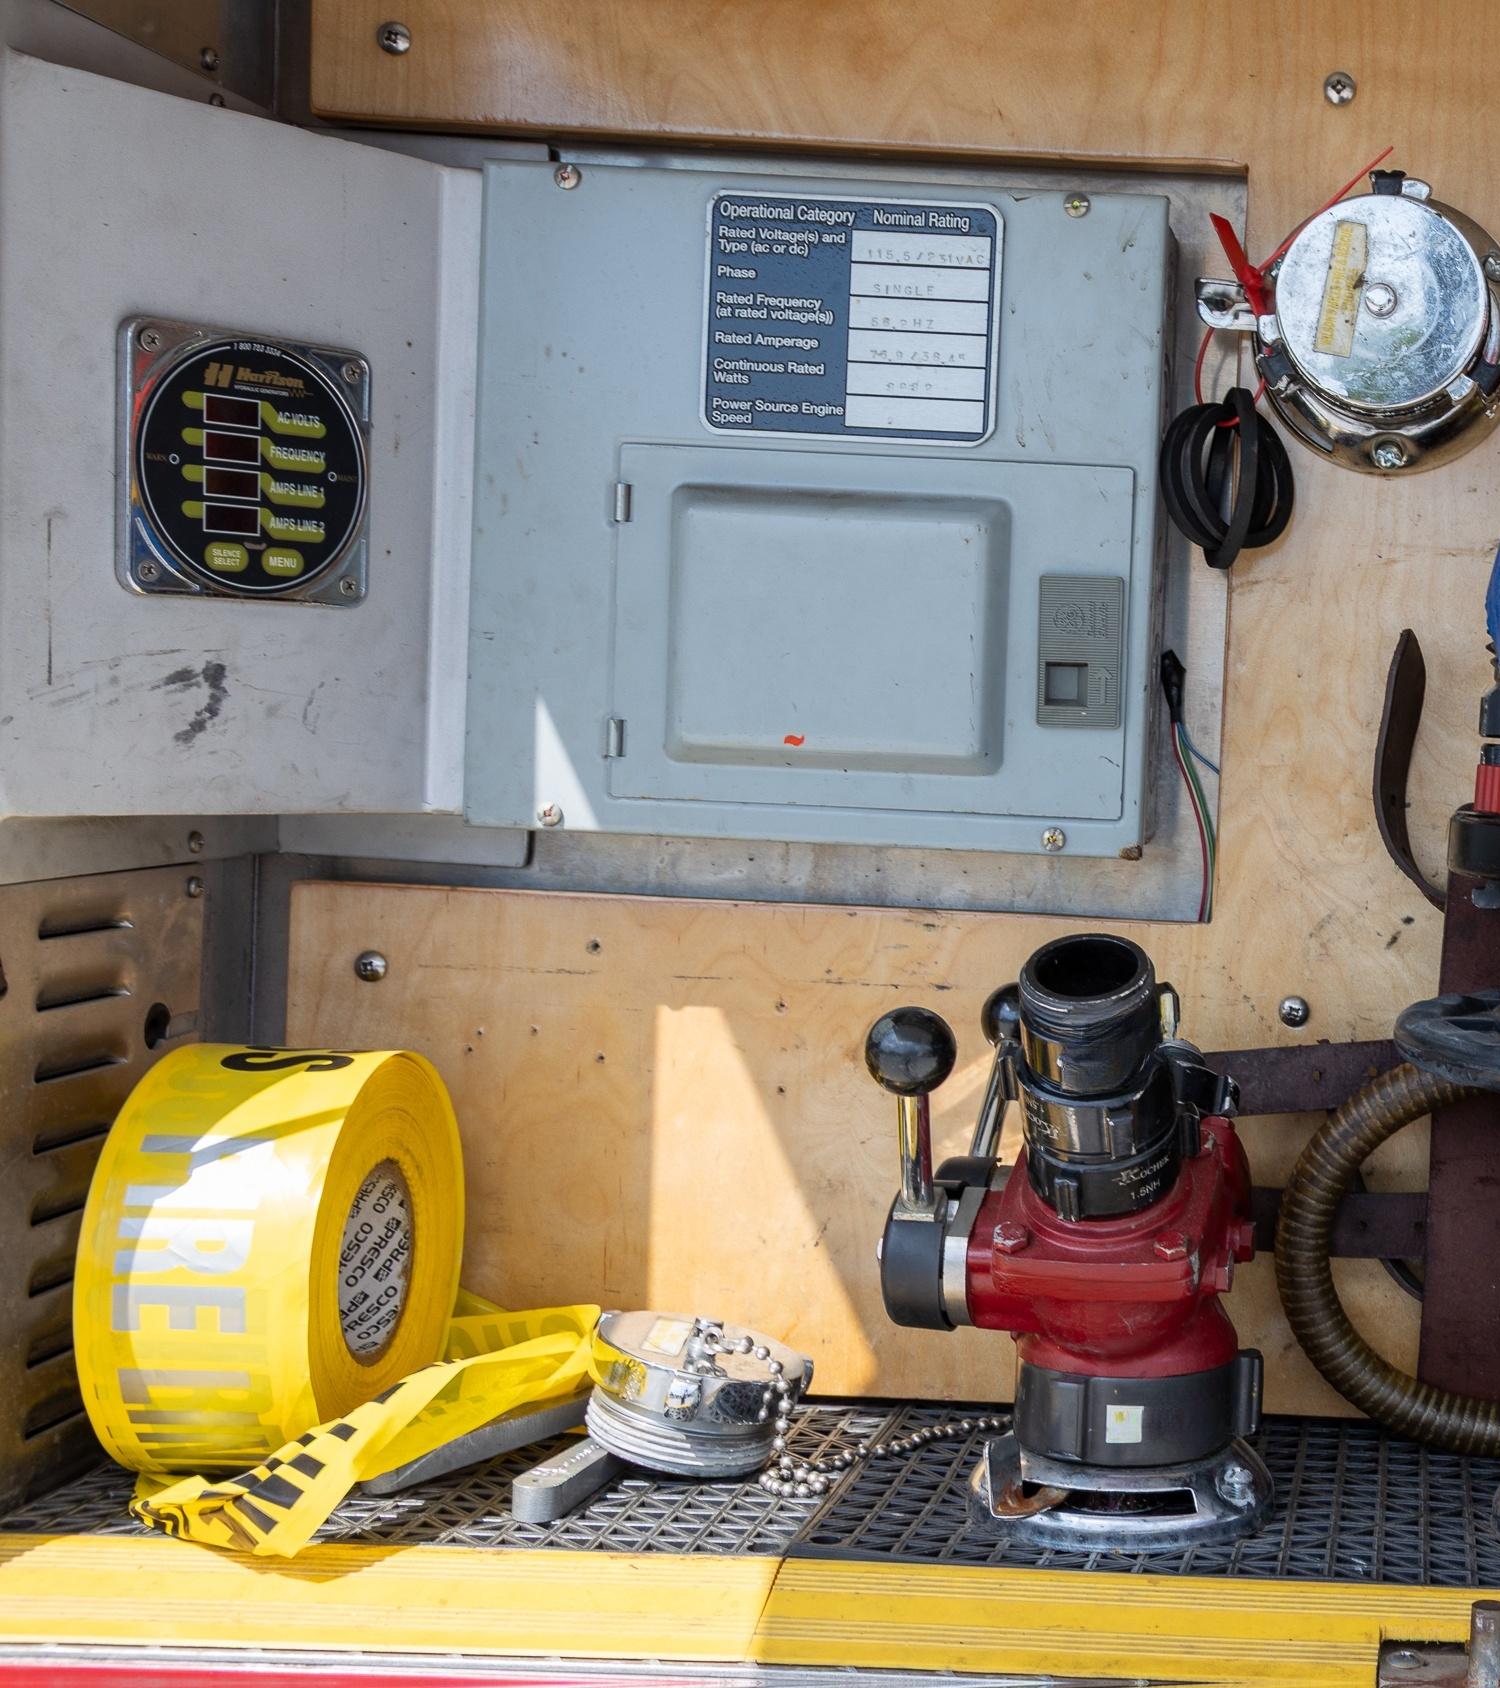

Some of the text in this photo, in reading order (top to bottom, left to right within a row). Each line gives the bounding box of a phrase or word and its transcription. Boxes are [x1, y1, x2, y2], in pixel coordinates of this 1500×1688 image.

[720, 200, 970, 232] Operational Category Nominal Rating
[719, 225, 846, 244] Rated Voltage(s) and
[718, 238, 809, 257] Type (ac or dc)
[717, 265, 757, 279] Phase
[873, 283, 935, 297] SINGLE
[716, 291, 822, 310] Rated Frequency
[715, 307, 834, 325] (at rated voltage(s))
[714, 331, 819, 350] Rated Amperage
[714, 358, 825, 375] Continuous Rated
[713, 371, 749, 384] Watts
[712, 397, 844, 417] Power Source Engine
[277, 411, 320, 427] AC VOLTS
[711, 410, 752, 424] Speed
[269, 446, 326, 463] FREQUENCY
[269, 481, 297, 496] AMPS
[297, 483, 318, 497] LINE
[269, 517, 325, 533] AMPS LINE 2
[212, 548, 241, 559] SILENCE
[213, 557, 240, 567] SELECT
[269, 556, 297, 569] MENU
[345, 1225, 396, 1287] PRESCO
